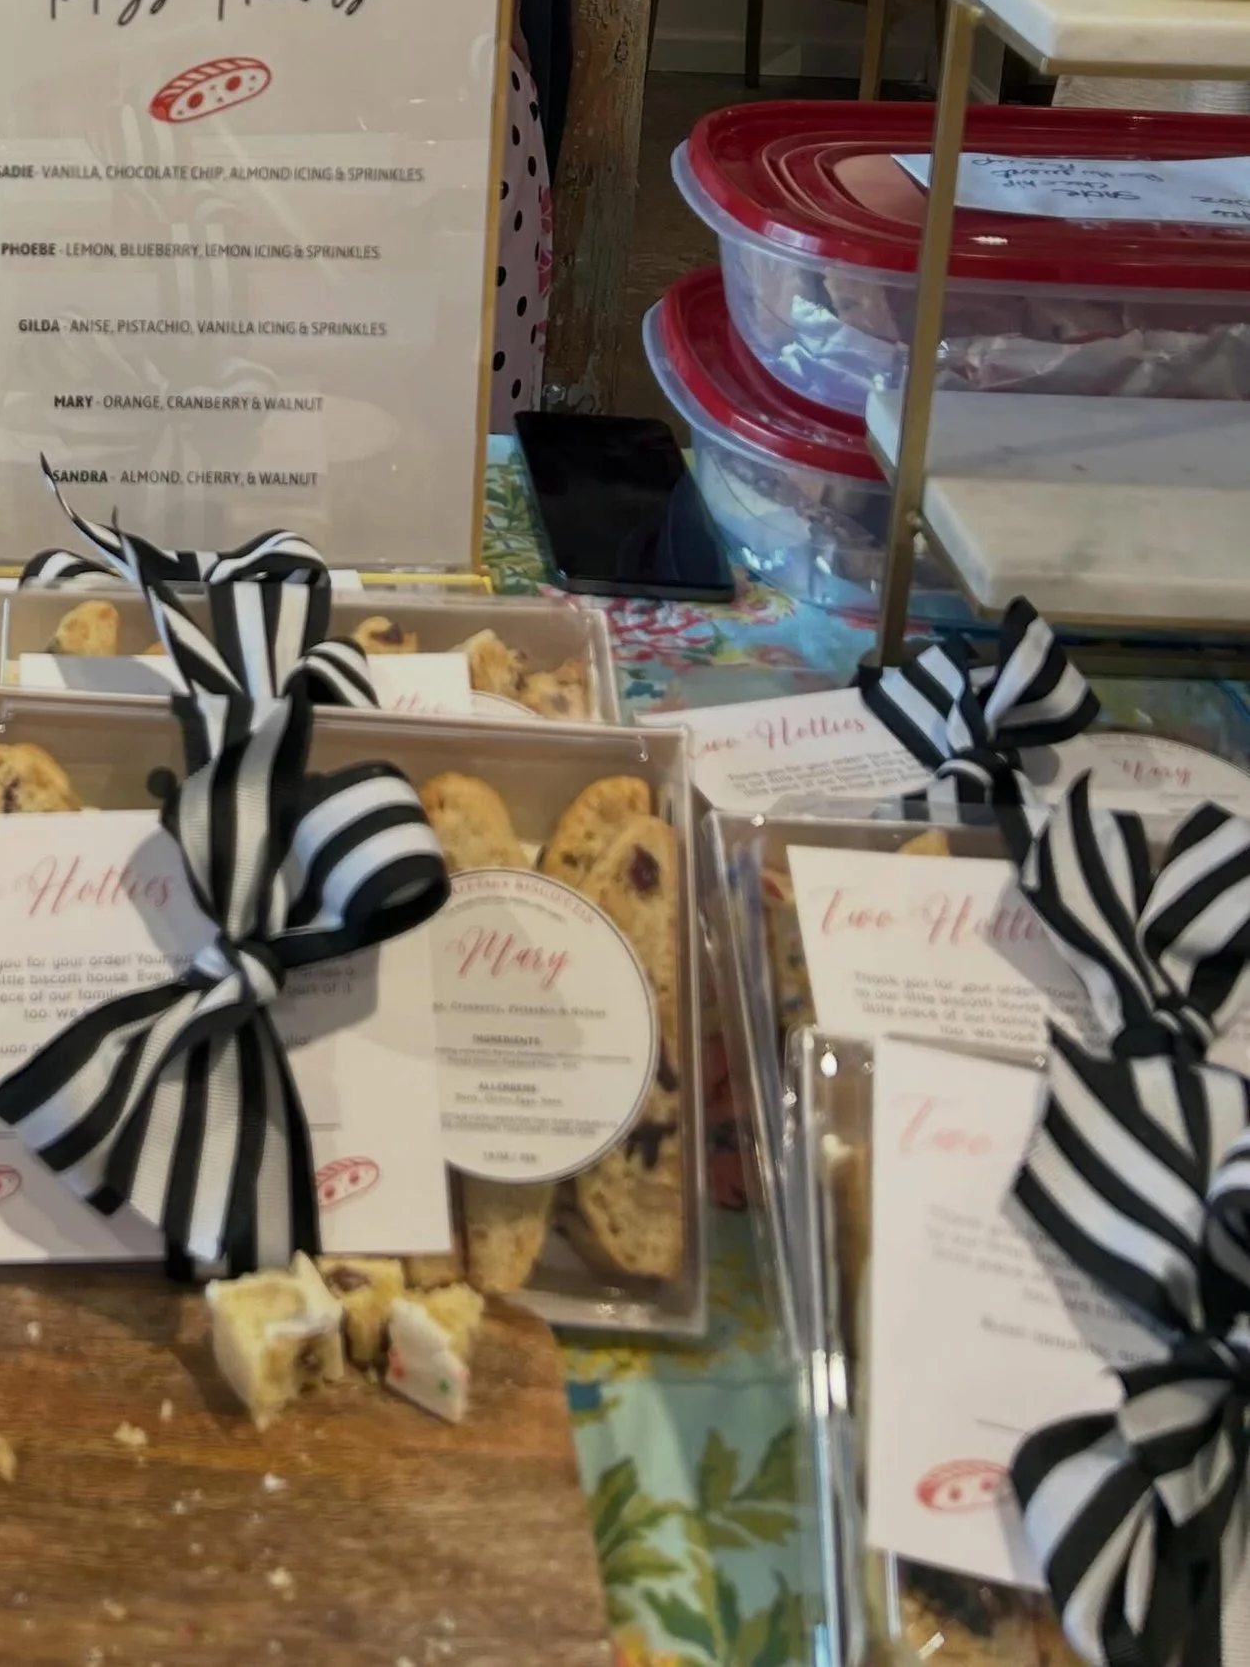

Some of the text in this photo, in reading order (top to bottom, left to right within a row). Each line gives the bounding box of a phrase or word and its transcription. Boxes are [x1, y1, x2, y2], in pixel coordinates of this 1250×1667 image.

[105, 165, 187, 180] CHOCOLATE
[229, 166, 290, 181] ALMOND
[293, 166, 333, 182] ICING
[348, 167, 424, 182] SPRINKLES
[0, 242, 57, 256] PHOEBE
[205, 244, 250, 258] LEMON
[254, 244, 292, 258] ICING
[306, 245, 381, 260] SPRINKLES
[18, 319, 60, 332] GILDA
[197, 320, 254, 333] VANILLA
[258, 320, 295, 334] ICING
[311, 322, 387, 336] SPRINKLES
[54, 395, 94, 408] MARY
[167, 395, 249, 409] CRANBERRY
[264, 397, 324, 411] WALNUT
[52, 470, 108, 483] SANDRA
[259, 472, 318, 485] WALNUT
